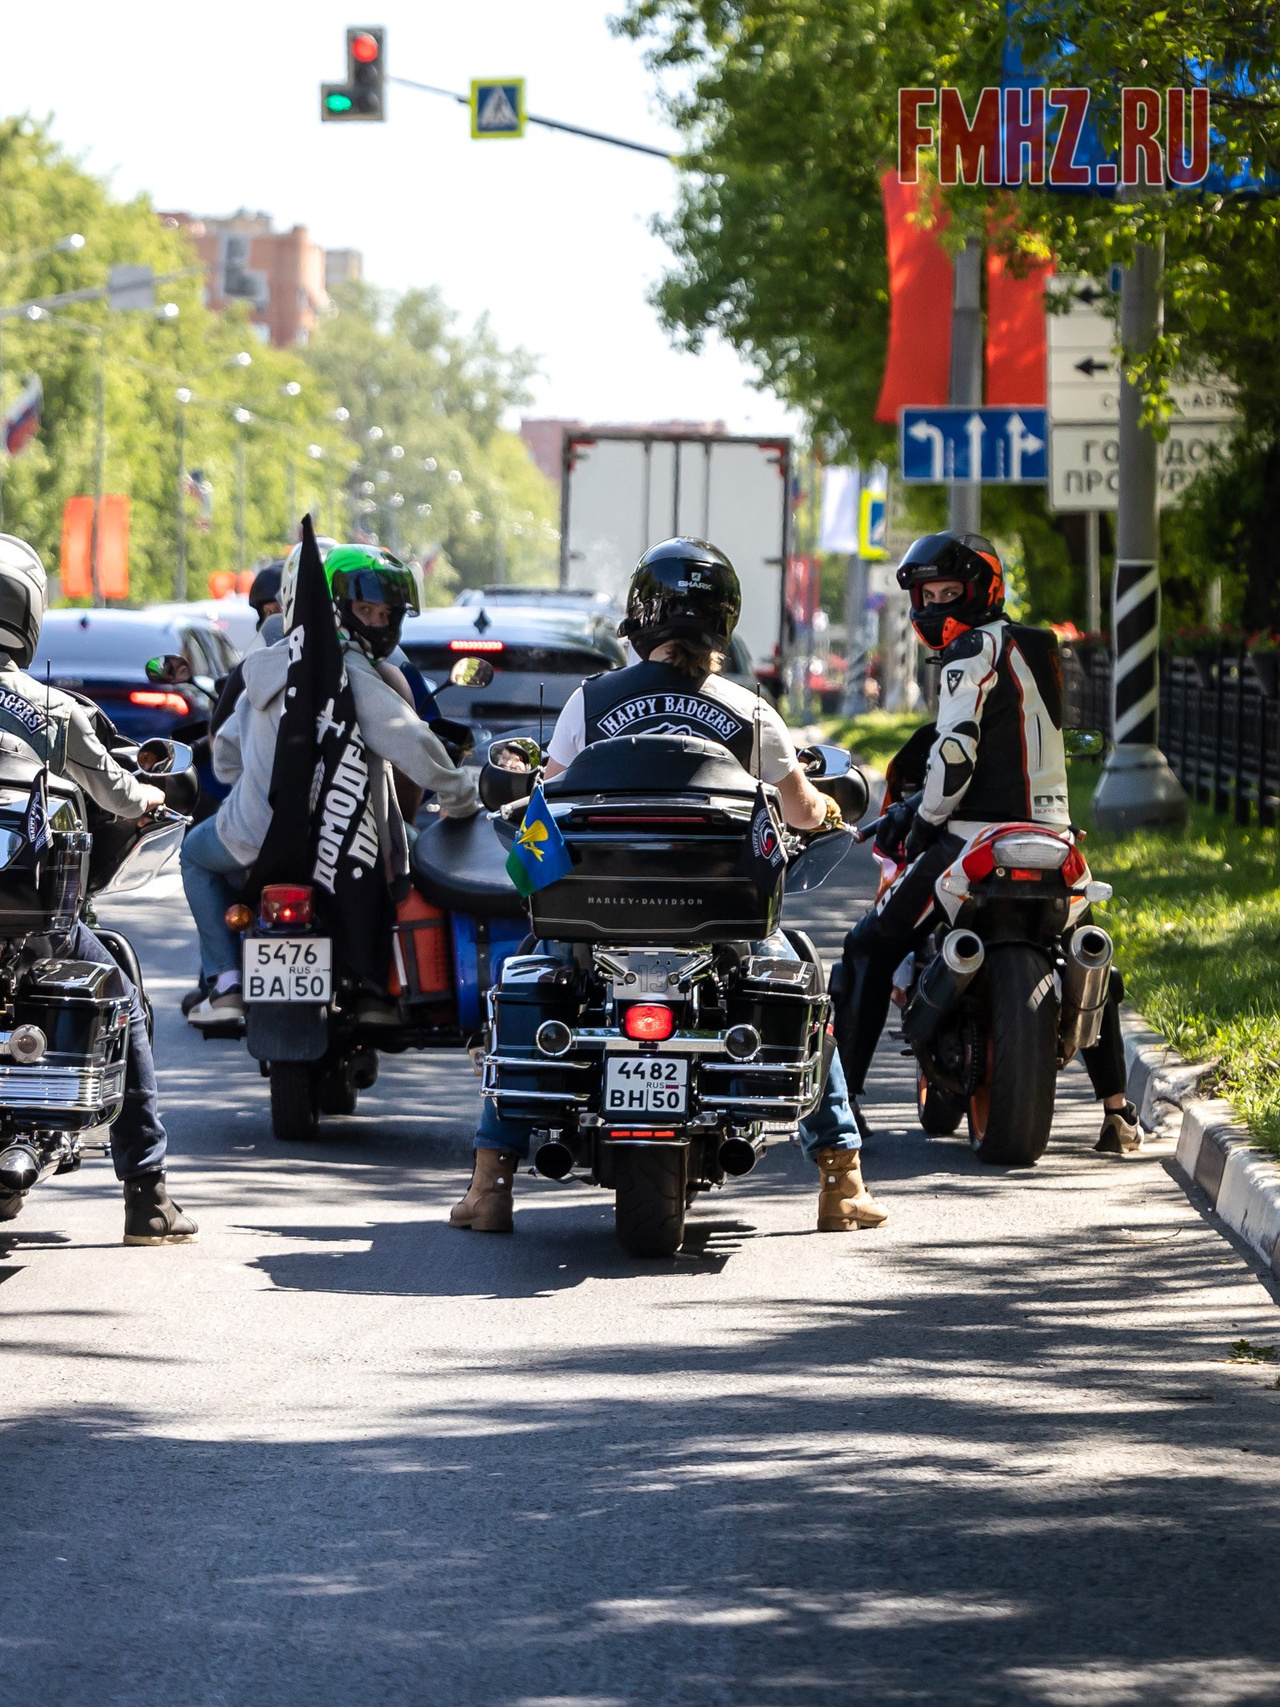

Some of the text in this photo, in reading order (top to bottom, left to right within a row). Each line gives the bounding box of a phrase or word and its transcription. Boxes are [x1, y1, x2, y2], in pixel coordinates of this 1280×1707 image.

[677, 580, 713, 591] SHARK
[602, 695, 737, 740] HAPPY BADGERS
[257, 943, 318, 965] 5476
[289, 965, 311, 974] RUS
[638, 964, 669, 993] 13
[249, 975, 325, 997] BA 50
[617, 1061, 678, 1081] 4482
[646, 1081, 665, 1089] RUS
[610, 1089, 680, 1109] BH 50
